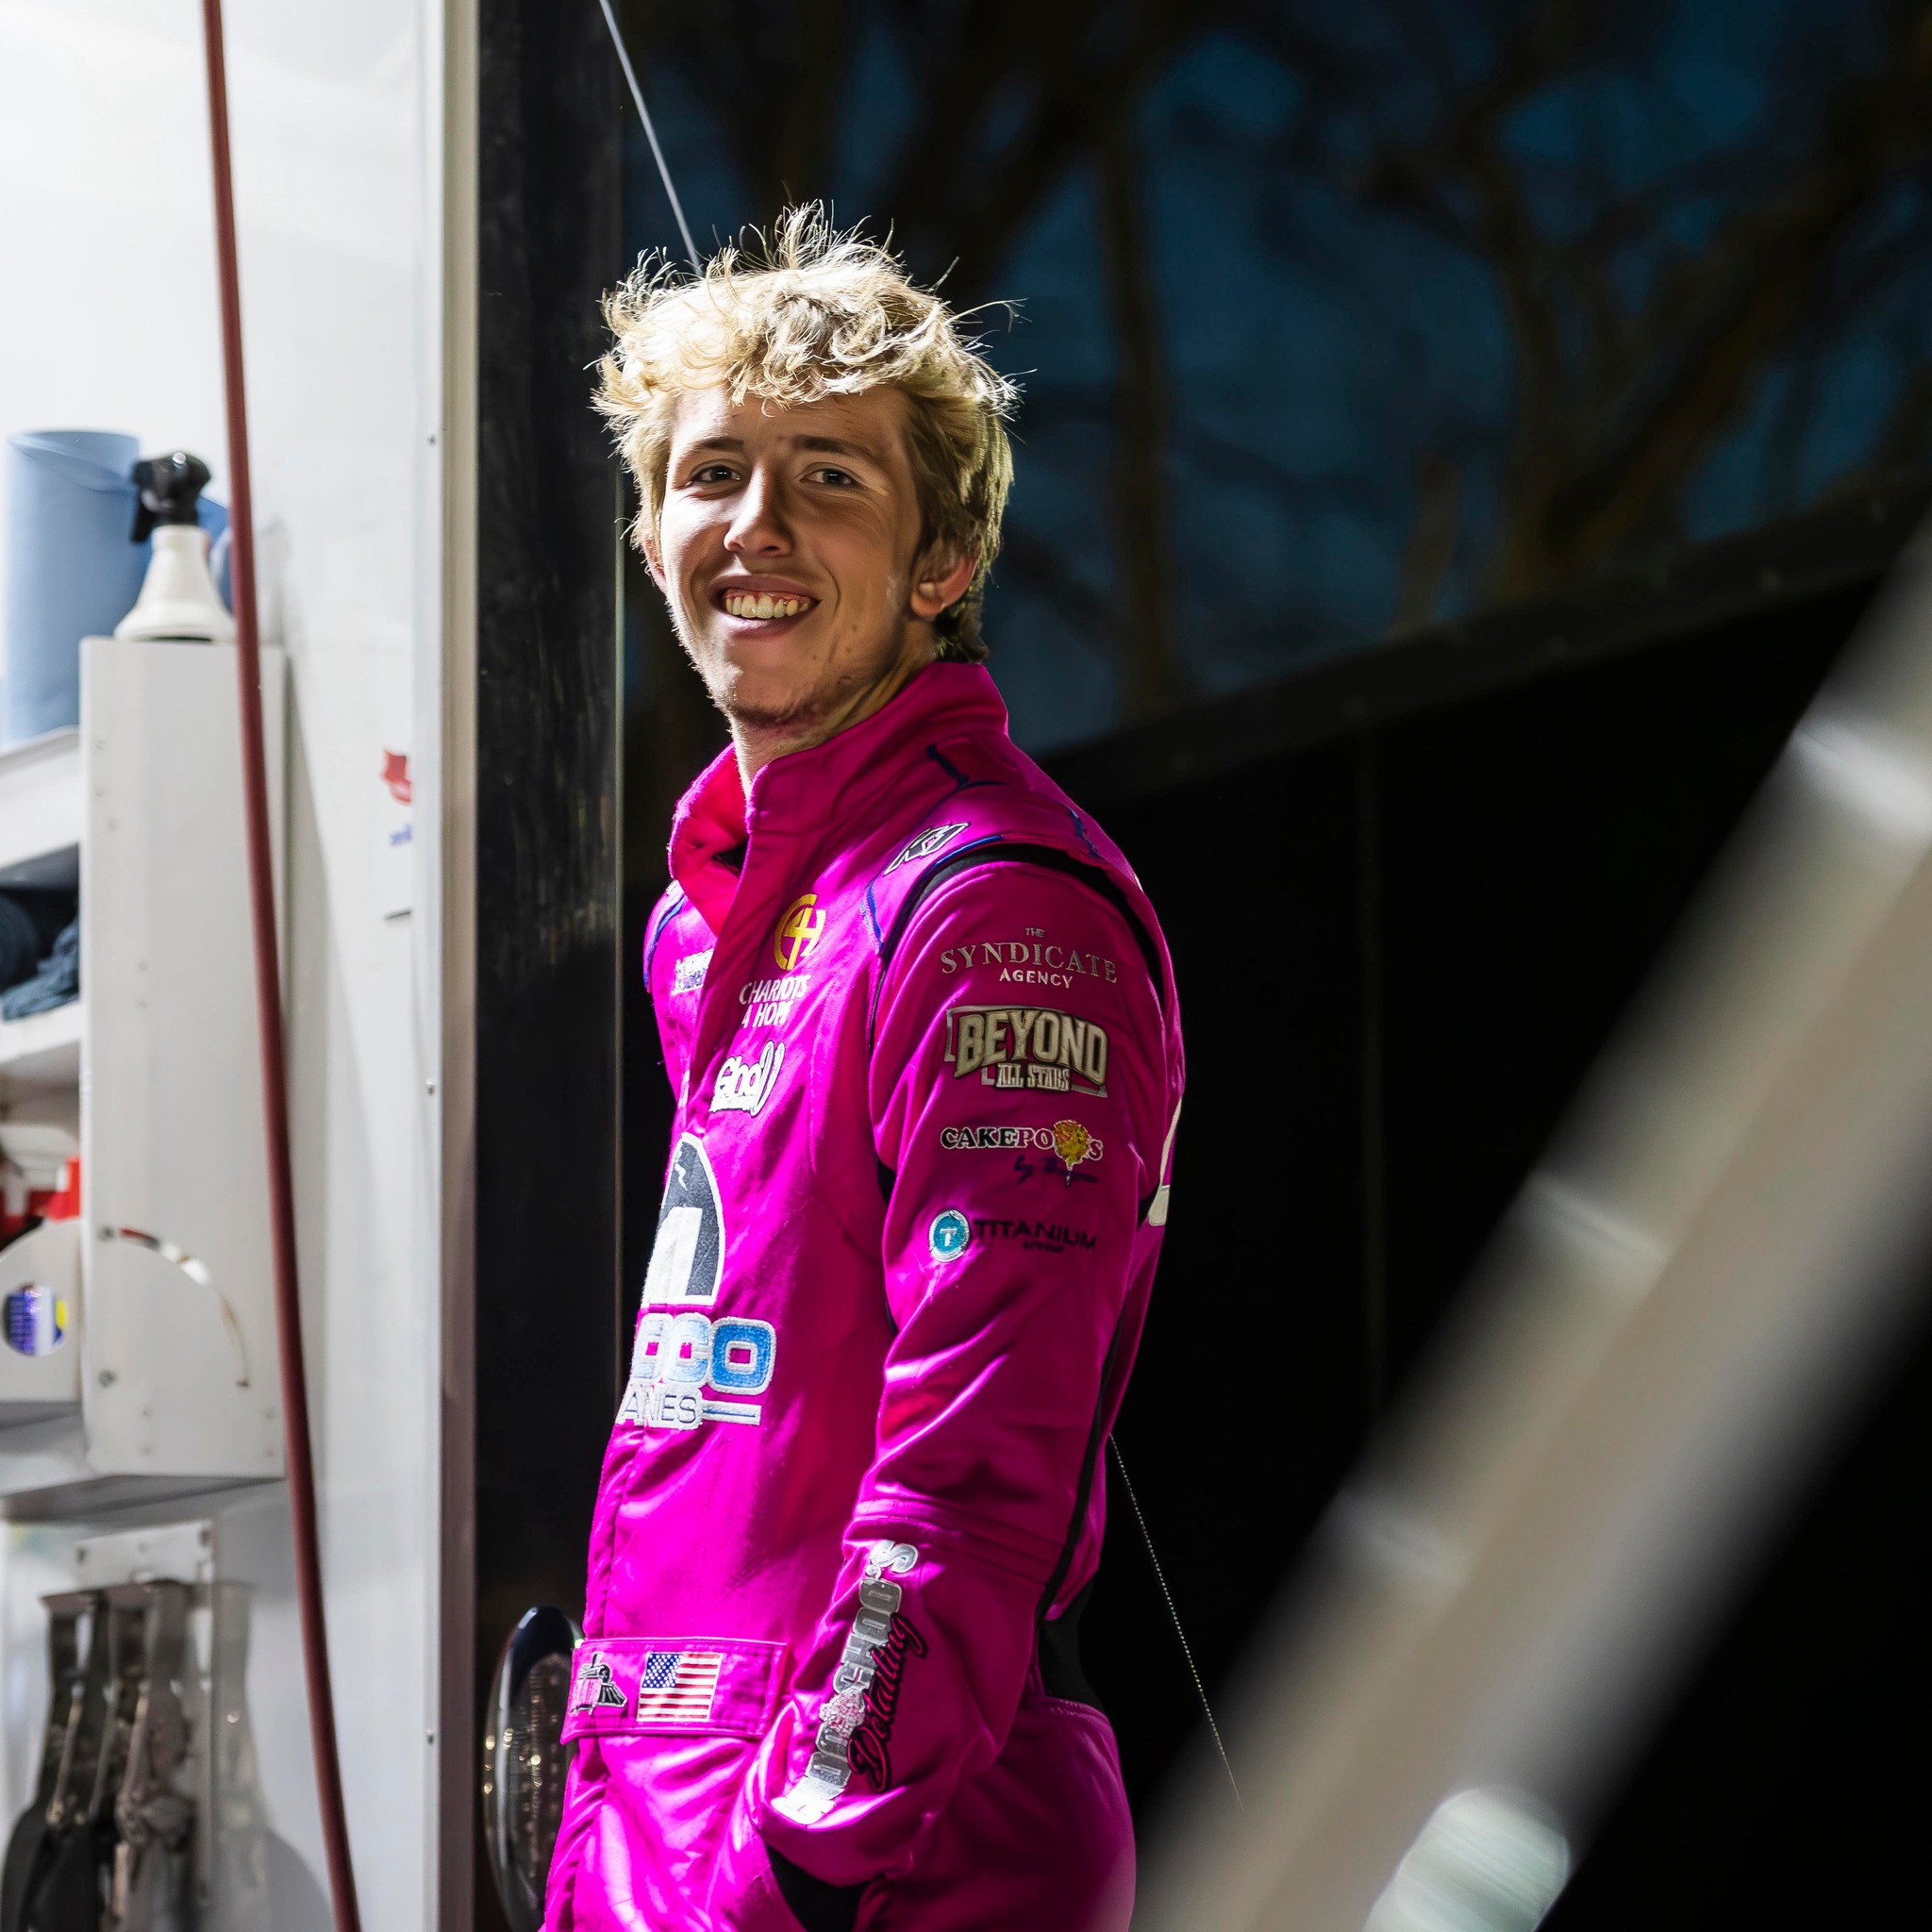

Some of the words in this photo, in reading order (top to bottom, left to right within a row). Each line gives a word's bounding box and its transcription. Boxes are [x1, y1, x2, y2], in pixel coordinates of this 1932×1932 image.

[1025, 927, 1045, 938] THE
[940, 941, 1118, 984] SYNDICATE
[999, 968, 1074, 990] AGENCY
[954, 1008, 1108, 1087] BEYOND
[995, 1063, 1024, 1089] ALL
[1027, 1063, 1072, 1092] STARS
[940, 1121, 1104, 1162] CAKEPOS
[974, 1219, 1097, 1251] TITANIUM
